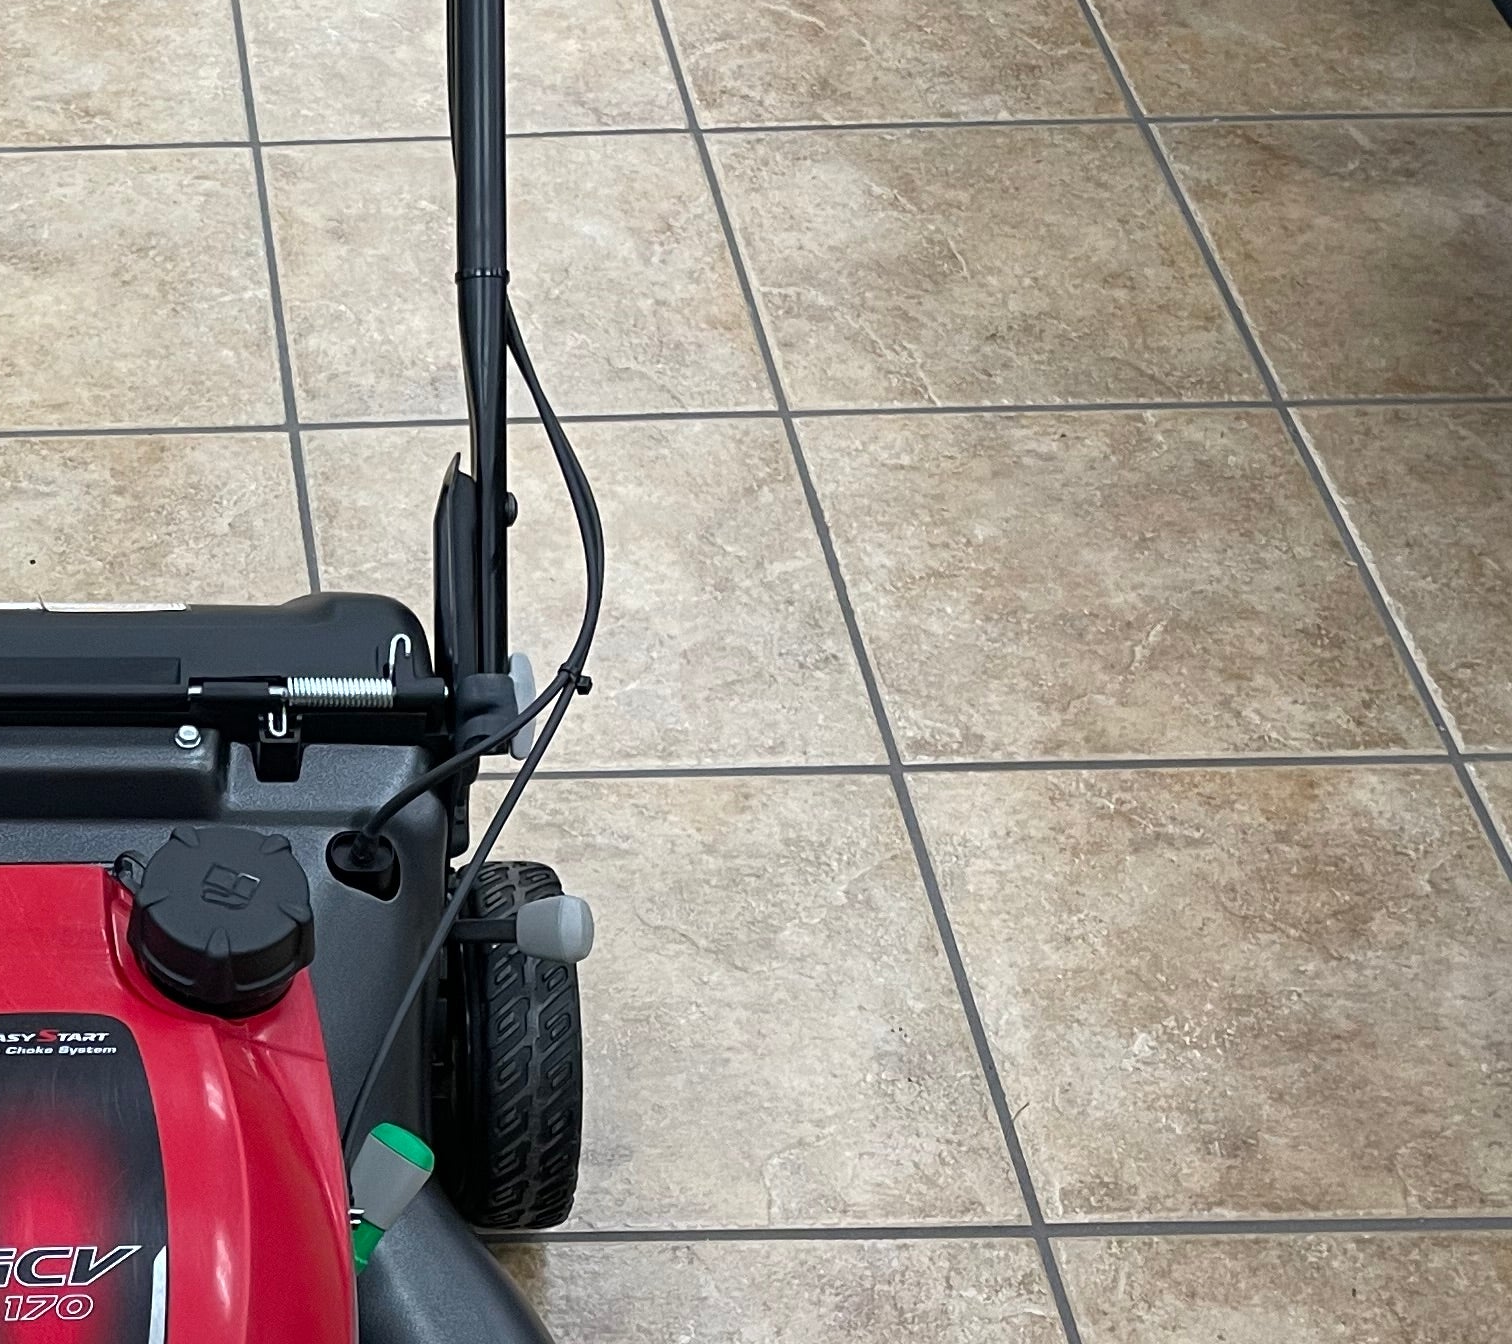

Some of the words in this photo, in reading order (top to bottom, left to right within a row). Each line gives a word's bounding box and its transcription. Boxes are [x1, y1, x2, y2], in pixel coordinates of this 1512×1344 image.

[38, 1029, 110, 1043] START
[5, 1046, 54, 1056] Choke
[58, 1046, 117, 1056] System
[4, 1294, 94, 1321] 170
